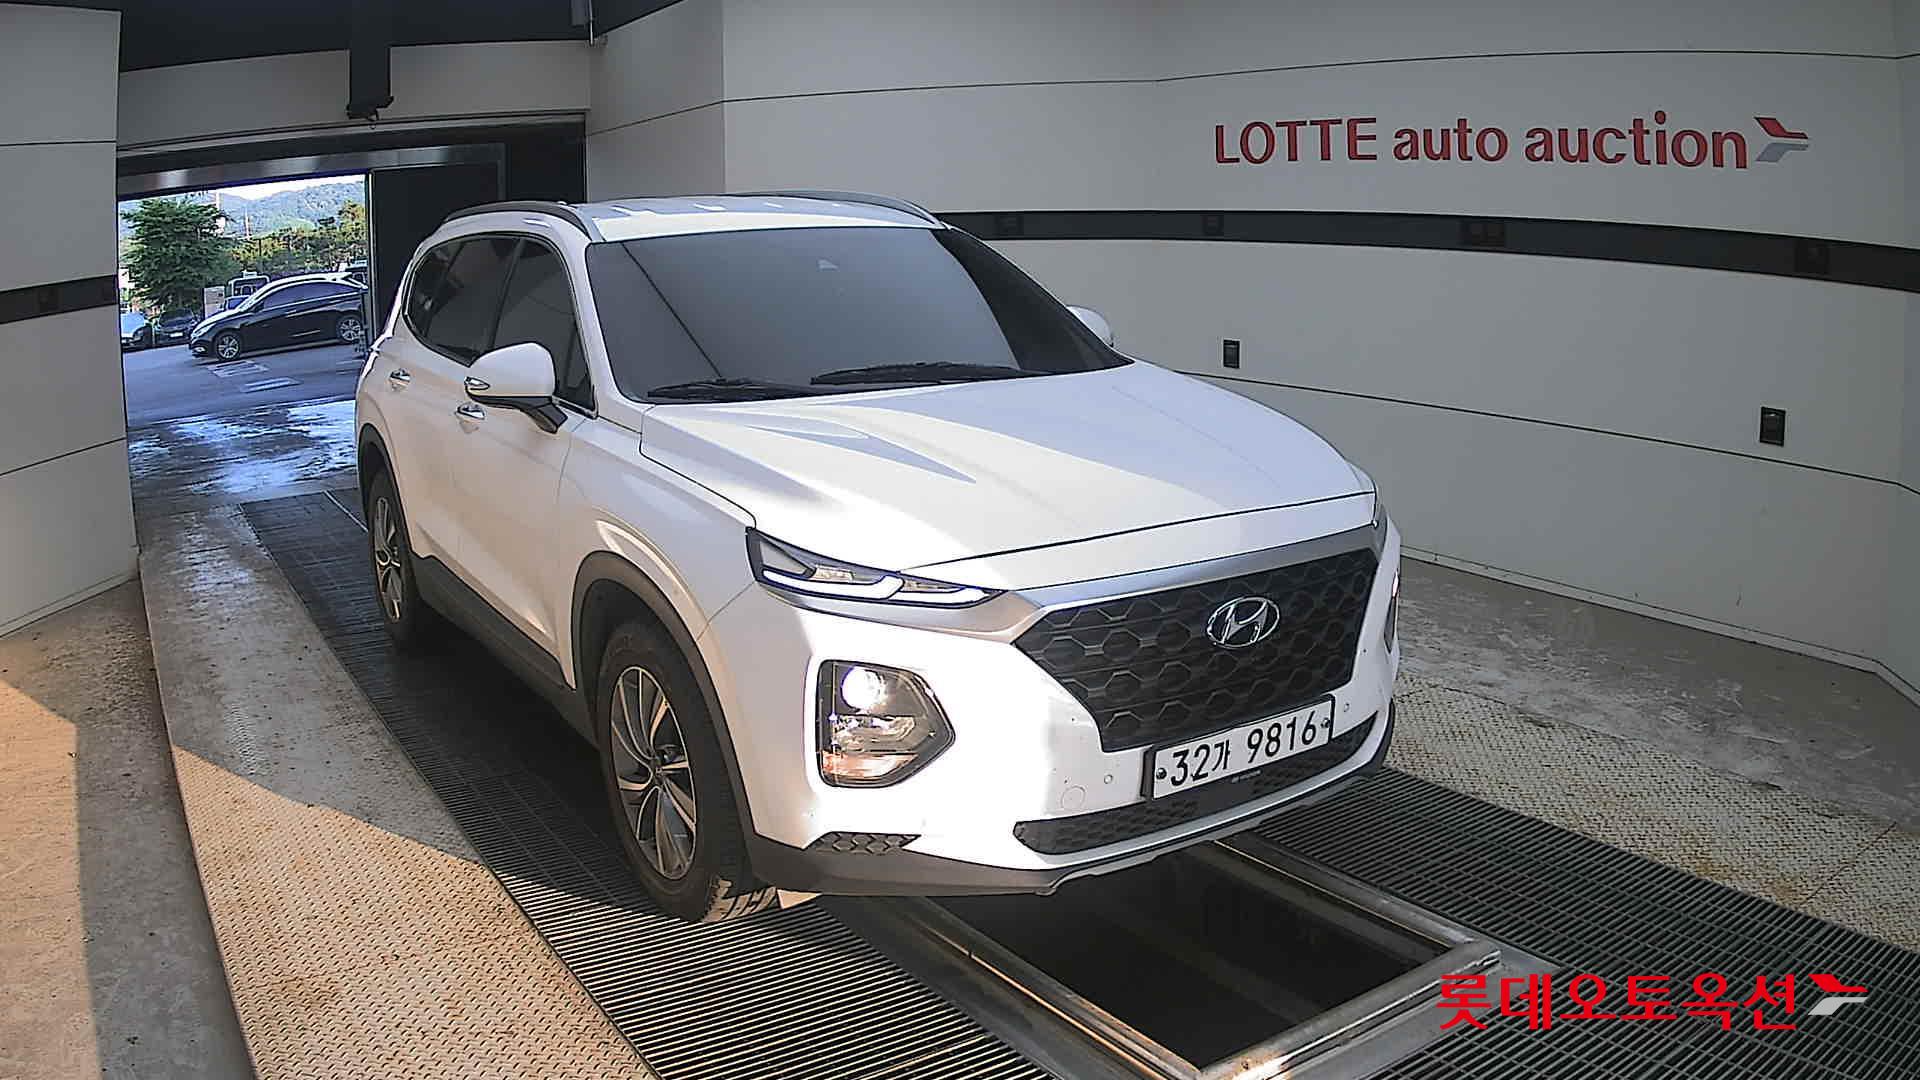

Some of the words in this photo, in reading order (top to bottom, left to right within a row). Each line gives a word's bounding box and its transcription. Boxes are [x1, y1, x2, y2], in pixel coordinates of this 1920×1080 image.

[1214, 116, 1378, 165] LOTTE
[1391, 117, 1509, 163] auto
[1523, 109, 1749, 169] auction
[1170, 739, 1231, 786] 32가
[1247, 710, 1317, 764] 9816
